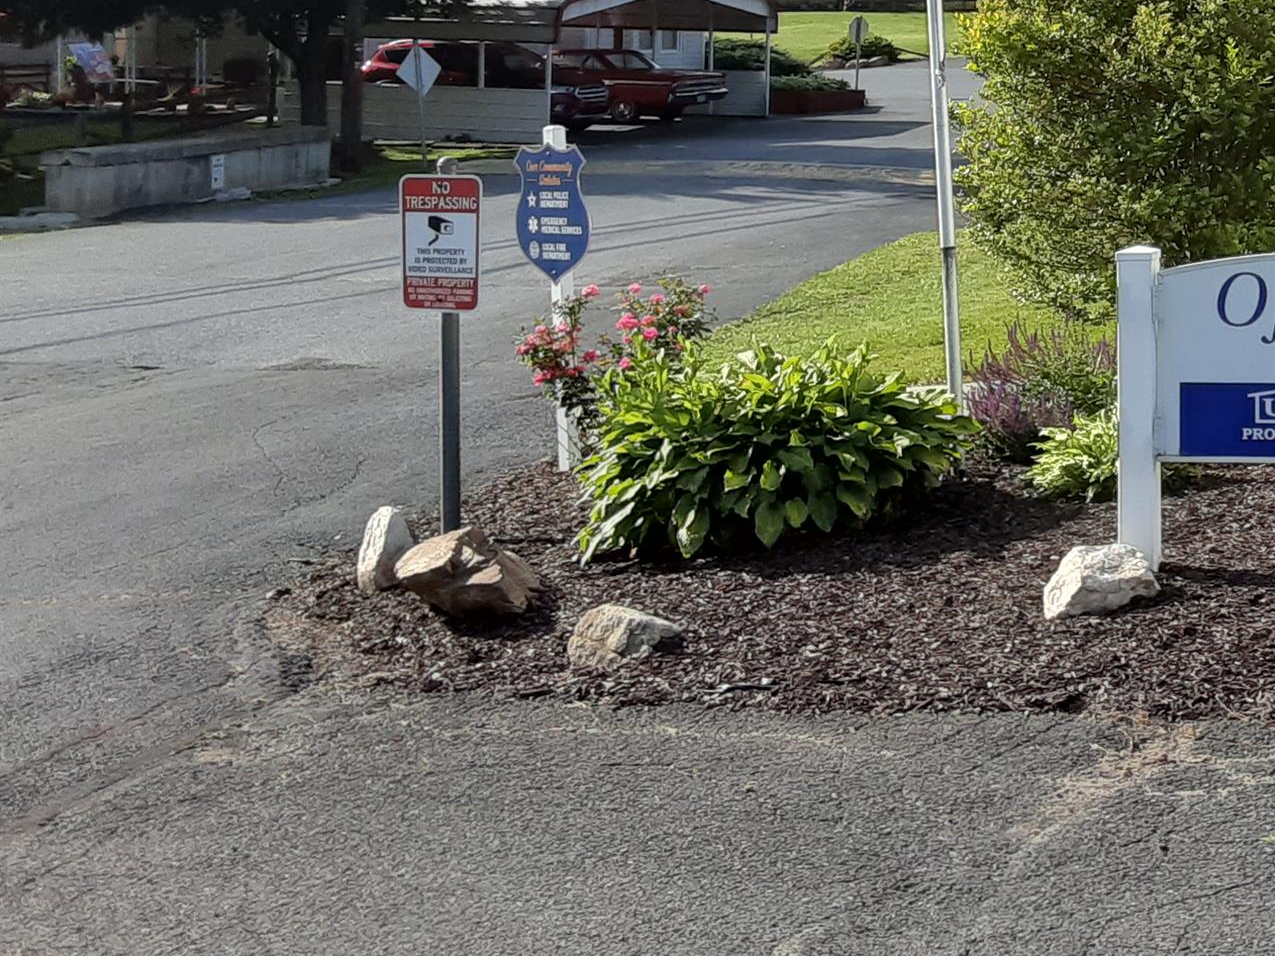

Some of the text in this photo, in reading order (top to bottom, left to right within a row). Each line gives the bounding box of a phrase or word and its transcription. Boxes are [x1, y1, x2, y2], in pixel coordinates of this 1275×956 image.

[432, 181, 450, 194] NO
[405, 196, 477, 210] TRESPASSING
[417, 247, 465, 256] THIS PROPERTY
[414, 257, 467, 266] IS PROTECTED BY
[408, 266, 473, 275] VIDEO SURVEILLANCE
[407, 277, 474, 288] PRIVATE PROPERTY
